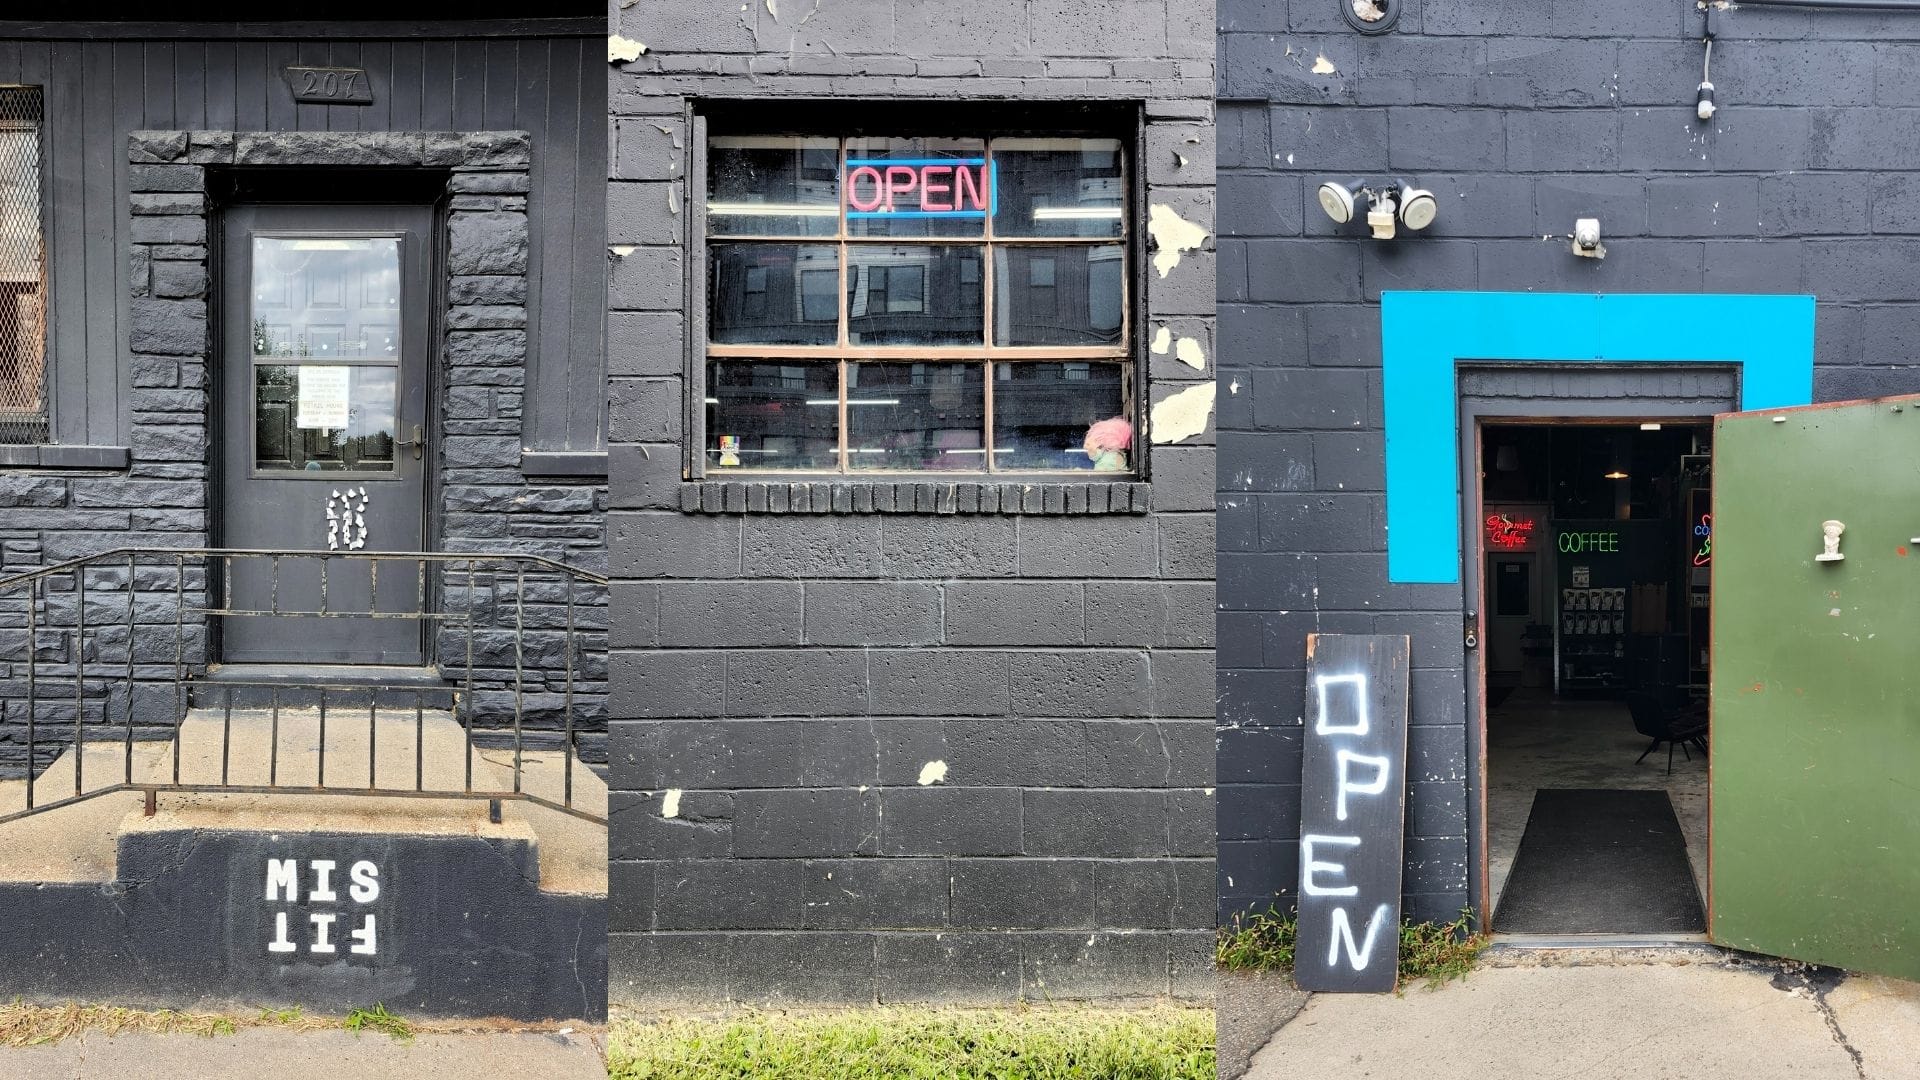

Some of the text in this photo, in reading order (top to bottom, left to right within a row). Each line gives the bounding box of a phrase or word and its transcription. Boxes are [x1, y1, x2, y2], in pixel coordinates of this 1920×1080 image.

[302, 71, 358, 99] 207
[848, 166, 987, 211] OPEN
[1486, 515, 1534, 530] Gourmet
[1491, 531, 1527, 547] Coffee
[1559, 532, 1619, 553] COFFEE
[1303, 673, 1390, 970] OPEN
[266, 858, 379, 903] MIS
